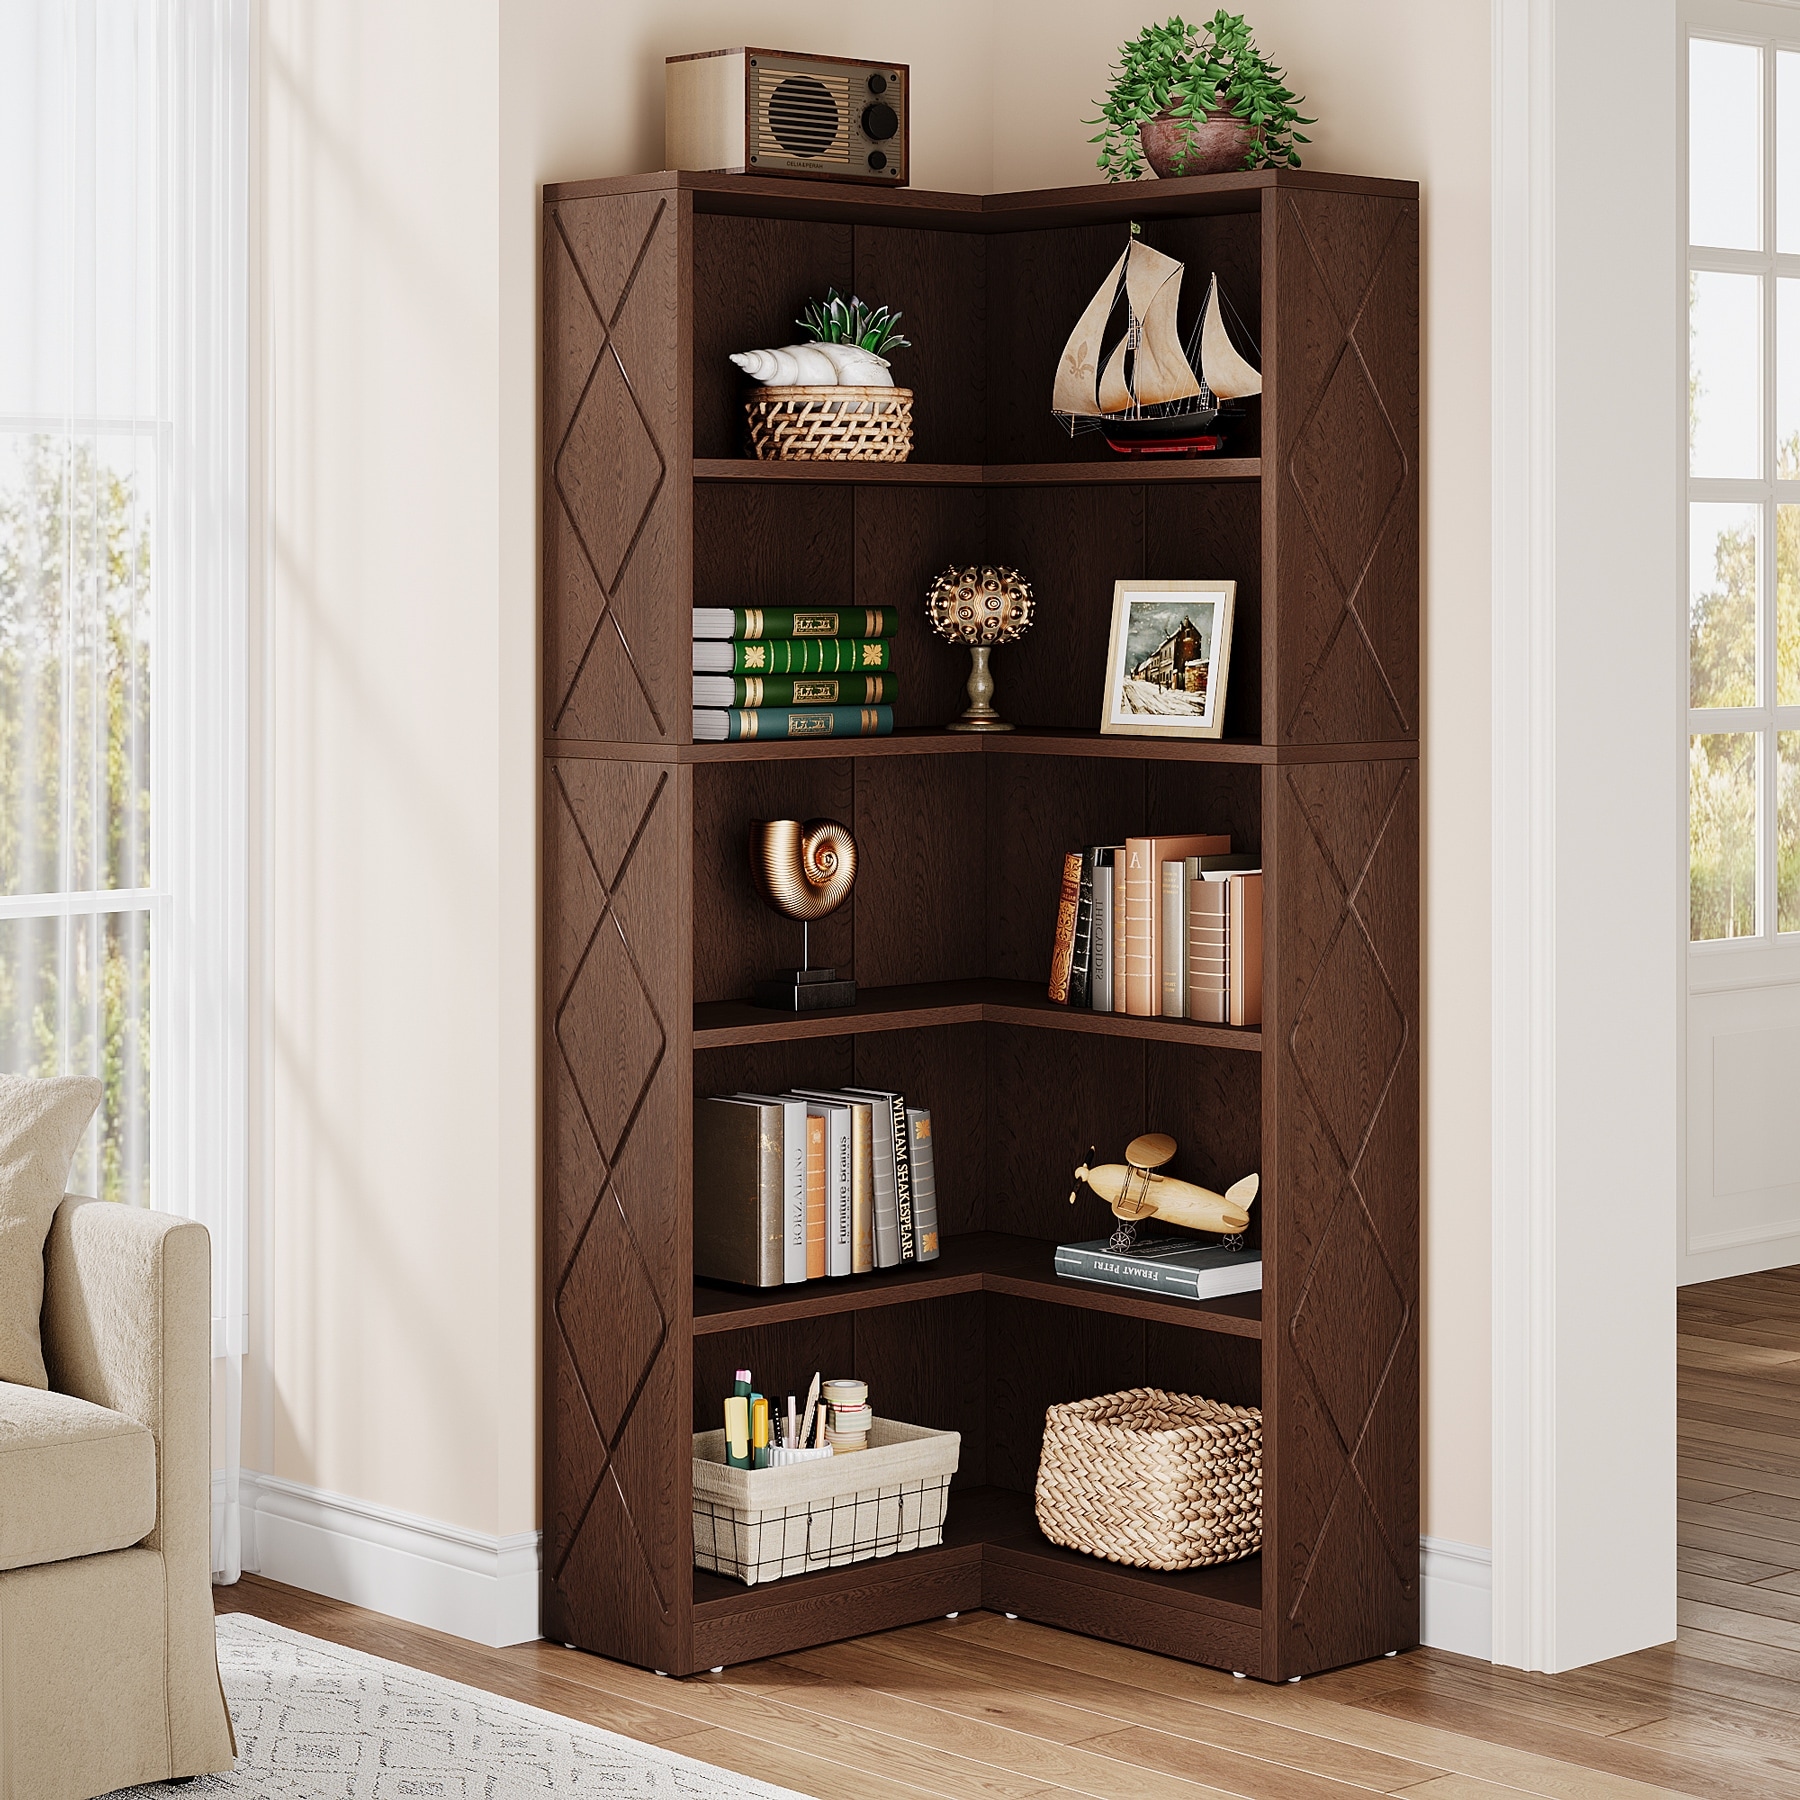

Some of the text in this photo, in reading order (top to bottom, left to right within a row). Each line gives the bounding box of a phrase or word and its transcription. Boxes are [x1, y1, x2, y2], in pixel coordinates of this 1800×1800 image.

[1129, 851, 1143, 869] A
[892, 1096, 914, 1260] WILLIAM SHAKESPEARE
[837, 1186, 847, 1245] Furniture
[1093, 1260, 1159, 1281] FERMAT PETRI
